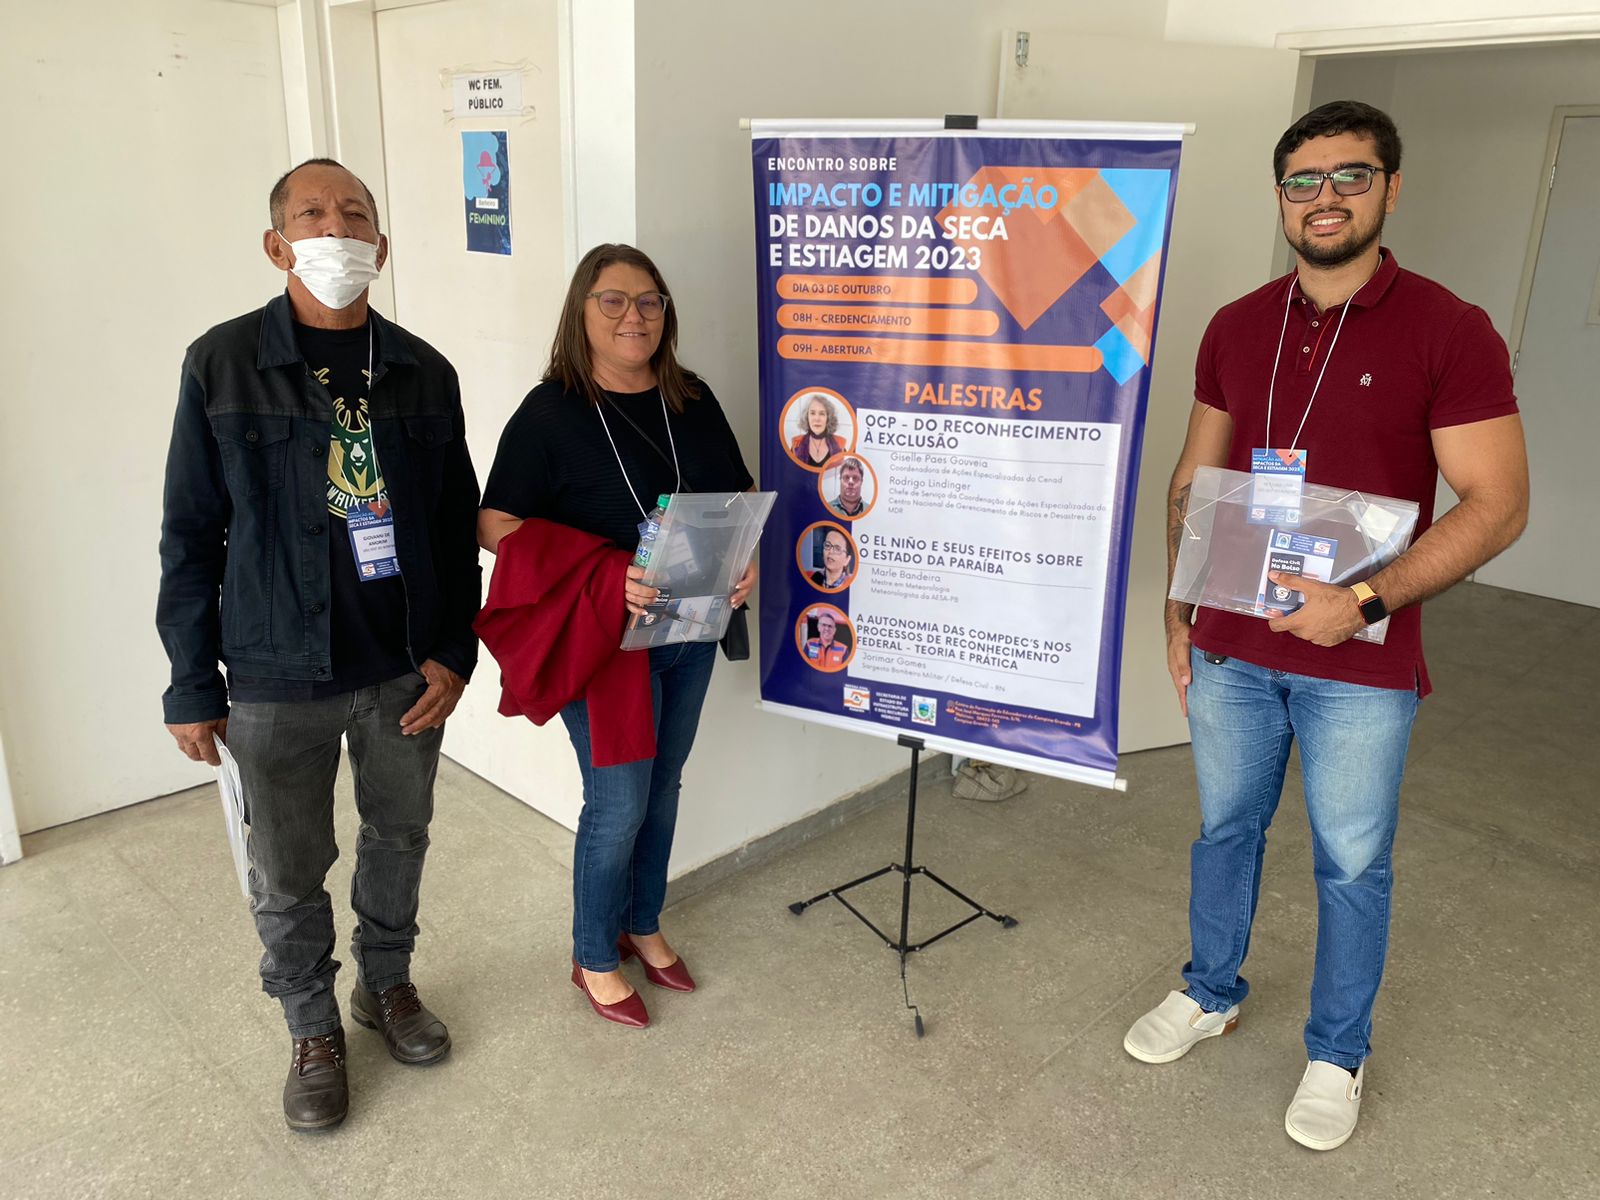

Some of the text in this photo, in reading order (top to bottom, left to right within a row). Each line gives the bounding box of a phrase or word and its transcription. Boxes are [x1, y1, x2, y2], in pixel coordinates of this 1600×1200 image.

[468, 78, 502, 91] WC FEM.
[468, 96, 504, 110] PÚBLICO
[768, 157, 898, 171] ENCONTRO SOBRE
[769, 178, 1058, 215] IMPACTO E MITIGAÇÃO
[469, 212, 506, 226] FEMININO
[769, 214, 1009, 241] DE DANOS DA SECA
[770, 243, 982, 270] E ESTIAGEM 2023
[792, 282, 892, 296] DIA 03 DE OUTUBRO
[792, 312, 812, 324] 08H
[821, 313, 912, 327] CREDENCIAMENTO
[792, 342, 812, 354] 09H
[821, 344, 873, 356] ABERTURA
[904, 382, 1044, 412] PALESTRAS
[865, 414, 897, 430] OCP
[914, 418, 938, 432] DO
[943, 418, 1102, 442] RECONHECIMENTO
[864, 428, 960, 450] À EXCLUSÃO
[890, 452, 988, 468] Giselle Paes Gouveia
[889, 476, 972, 492] Rodrigo Lindinger
[890, 464, 940, 475] Coordenadora
[952, 468, 972, 477] Ações
[974, 470, 1024, 483] Especializadas
[1038, 475, 1064, 484] Cenad
[888, 488, 909, 496] Chefe
[922, 491, 946, 500] Serviço
[959, 494, 1004, 506] Coordenação
[1006, 498, 1016, 506] de
[1017, 499, 1039, 509] Ações
[1040, 501, 1094, 512] Especializadas
[888, 497, 912, 506] Centro
[912, 499, 944, 508] Nacional
[956, 502, 1006, 516] Gerenciamento
[1008, 508, 1018, 516] de
[1020, 510, 1042, 519] Riscos
[1050, 511, 1085, 522] Desastres
[860, 533, 1084, 568] O EL NIÑO E SEUS EFEITOS SOBRE
[859, 547, 1004, 576] O ESTADO DA PARAÍBA
[1281, 564, 1300, 572] Bolso
[871, 566, 941, 583] Marle Bandeira
[905, 582, 950, 593] Meteorologia
[856, 613, 1072, 653] A AUTONOMIA DAS COMPDEC'S NOS
[856, 624, 1060, 664] PROCESSOS DE RECONHECIMENTO
[856, 636, 902, 652] FEDERAL
[915, 644, 956, 659] TEORIA
[960, 651, 966, 660] E
[969, 651, 1019, 671] PRÁTICA
[862, 652, 927, 670] Jorimar Gomes
